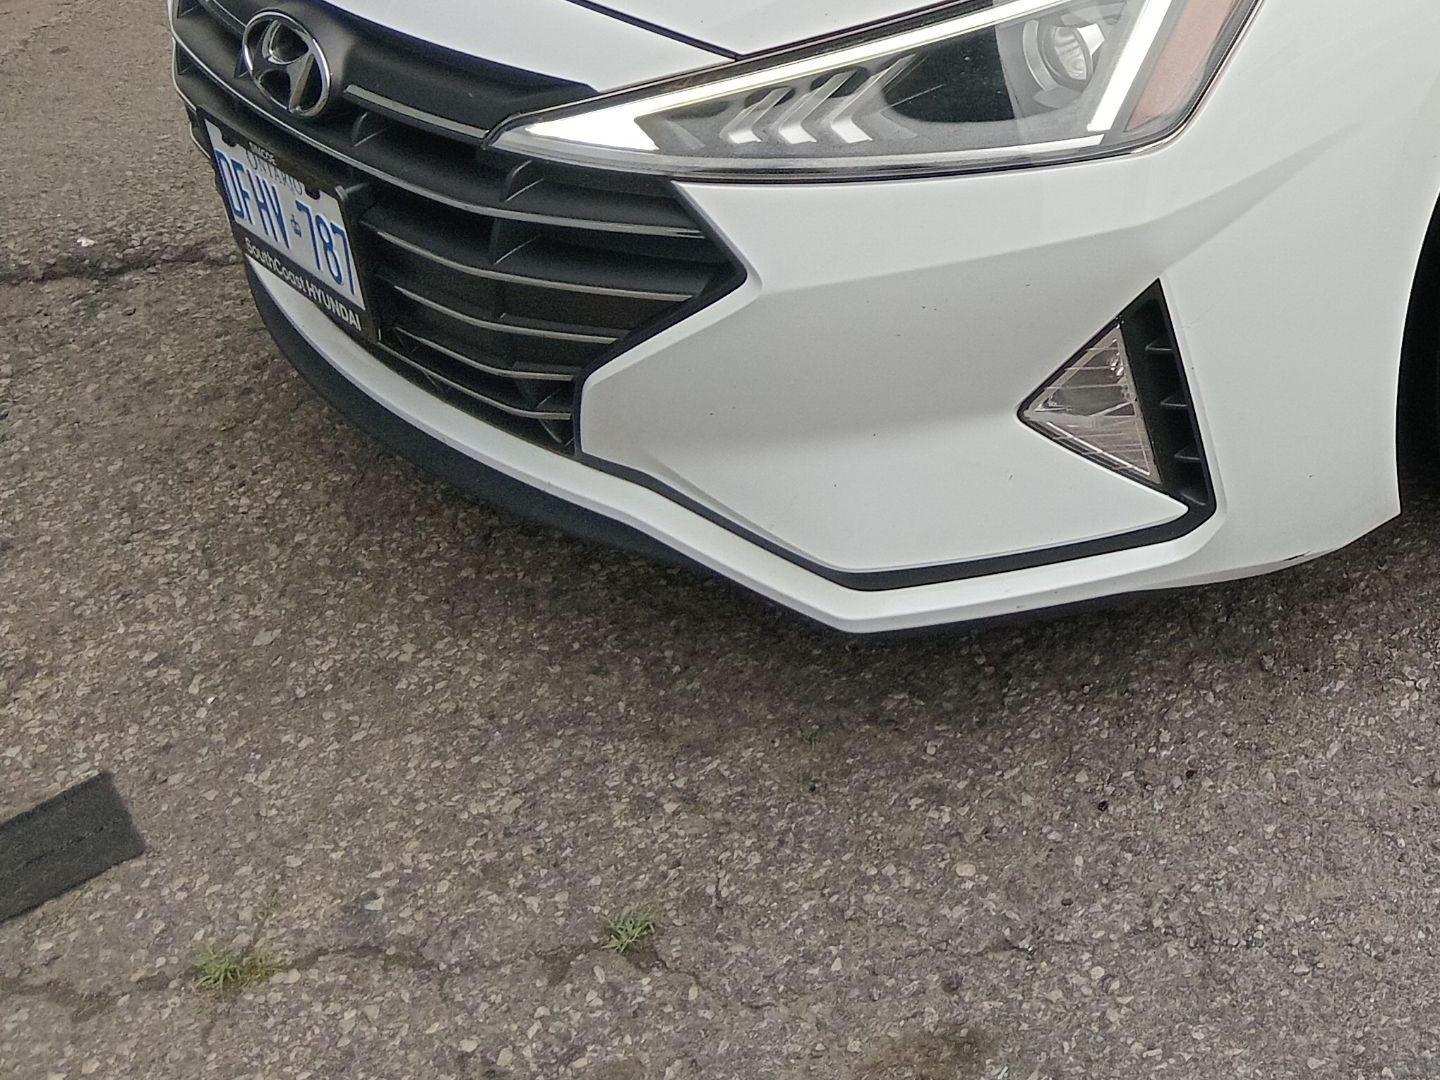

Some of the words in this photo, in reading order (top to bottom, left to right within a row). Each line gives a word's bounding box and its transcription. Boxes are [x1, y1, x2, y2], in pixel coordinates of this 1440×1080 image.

[214, 150, 290, 249] DFHV
[295, 200, 355, 297] 787
[244, 236, 308, 294] SouthCoast
[305, 279, 362, 332] HYUNDAI
